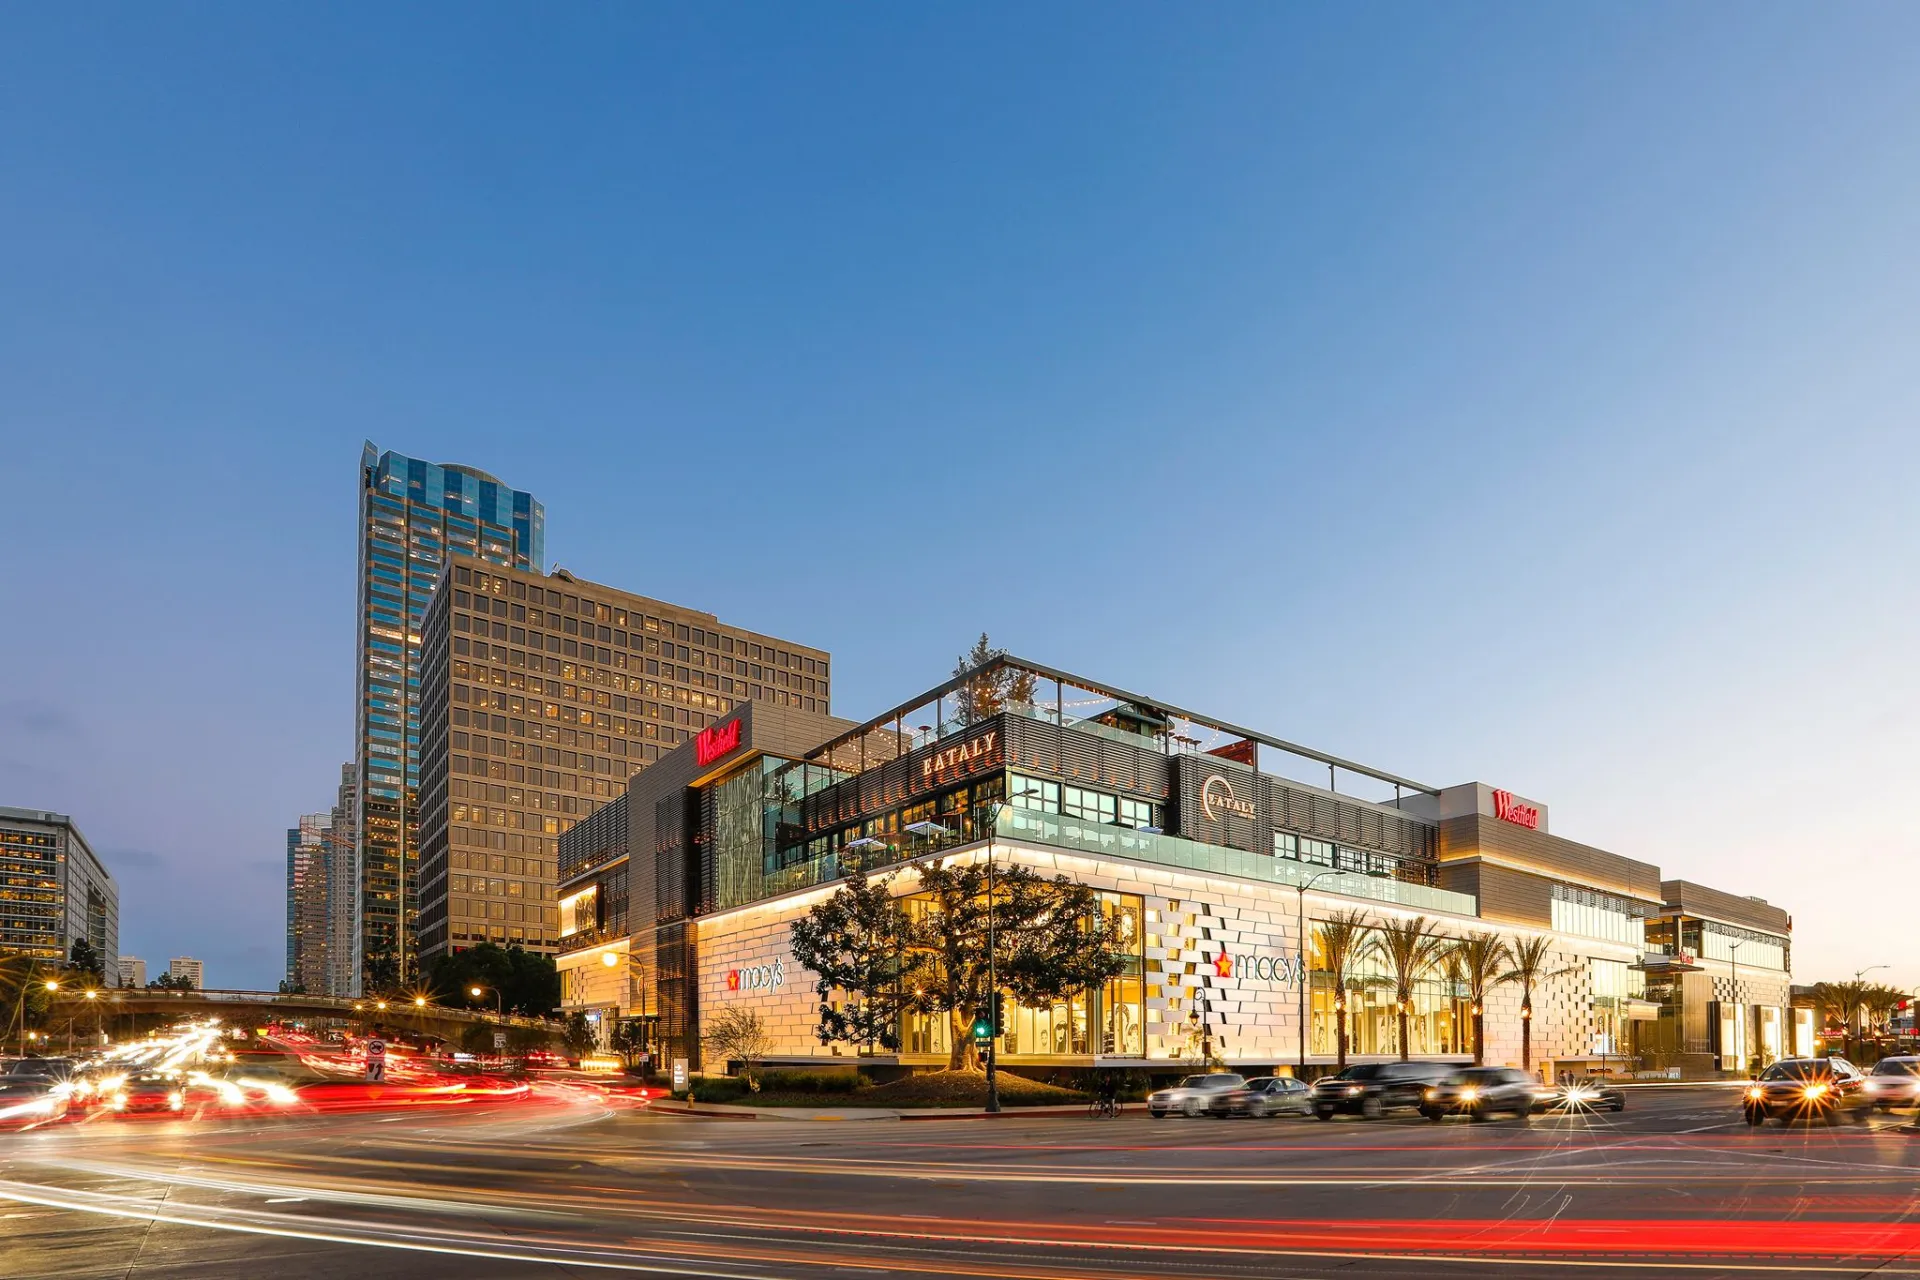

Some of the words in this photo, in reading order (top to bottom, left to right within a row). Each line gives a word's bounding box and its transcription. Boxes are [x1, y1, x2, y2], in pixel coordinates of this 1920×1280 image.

[923, 732, 995, 776] EATALY
[1208, 793, 1256, 814] EATALY
[1493, 789, 1538, 830] Westfield
[738, 956, 784, 995] macy's
[1235, 952, 1306, 990] macy's
